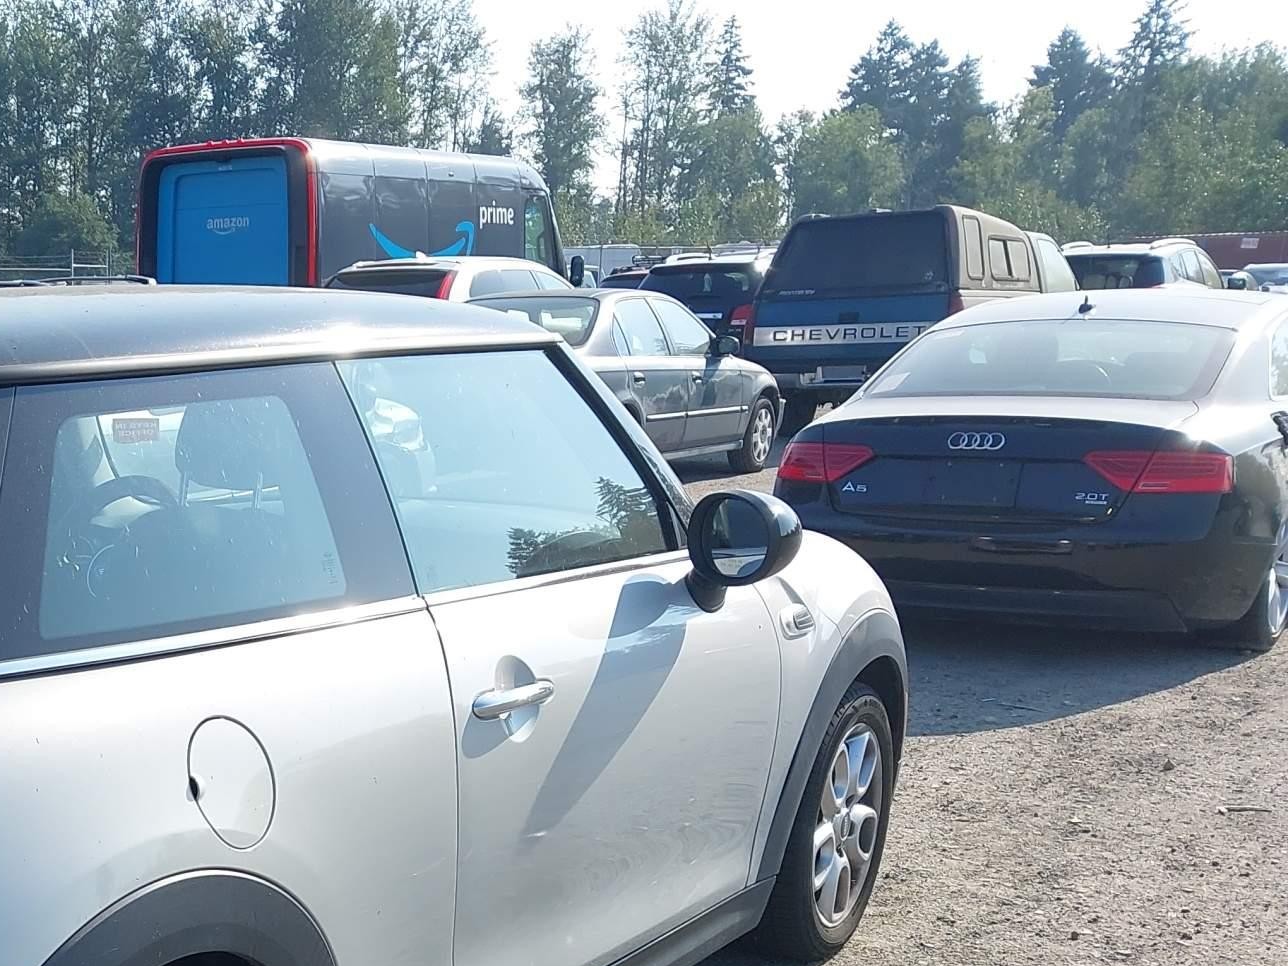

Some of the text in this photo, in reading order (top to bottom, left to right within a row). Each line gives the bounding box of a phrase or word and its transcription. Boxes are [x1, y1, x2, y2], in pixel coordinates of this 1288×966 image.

[479, 199, 515, 230] prime
[206, 216, 250, 230] amazon
[773, 325, 927, 342] CHEVROLET
[842, 481, 867, 492] A5
